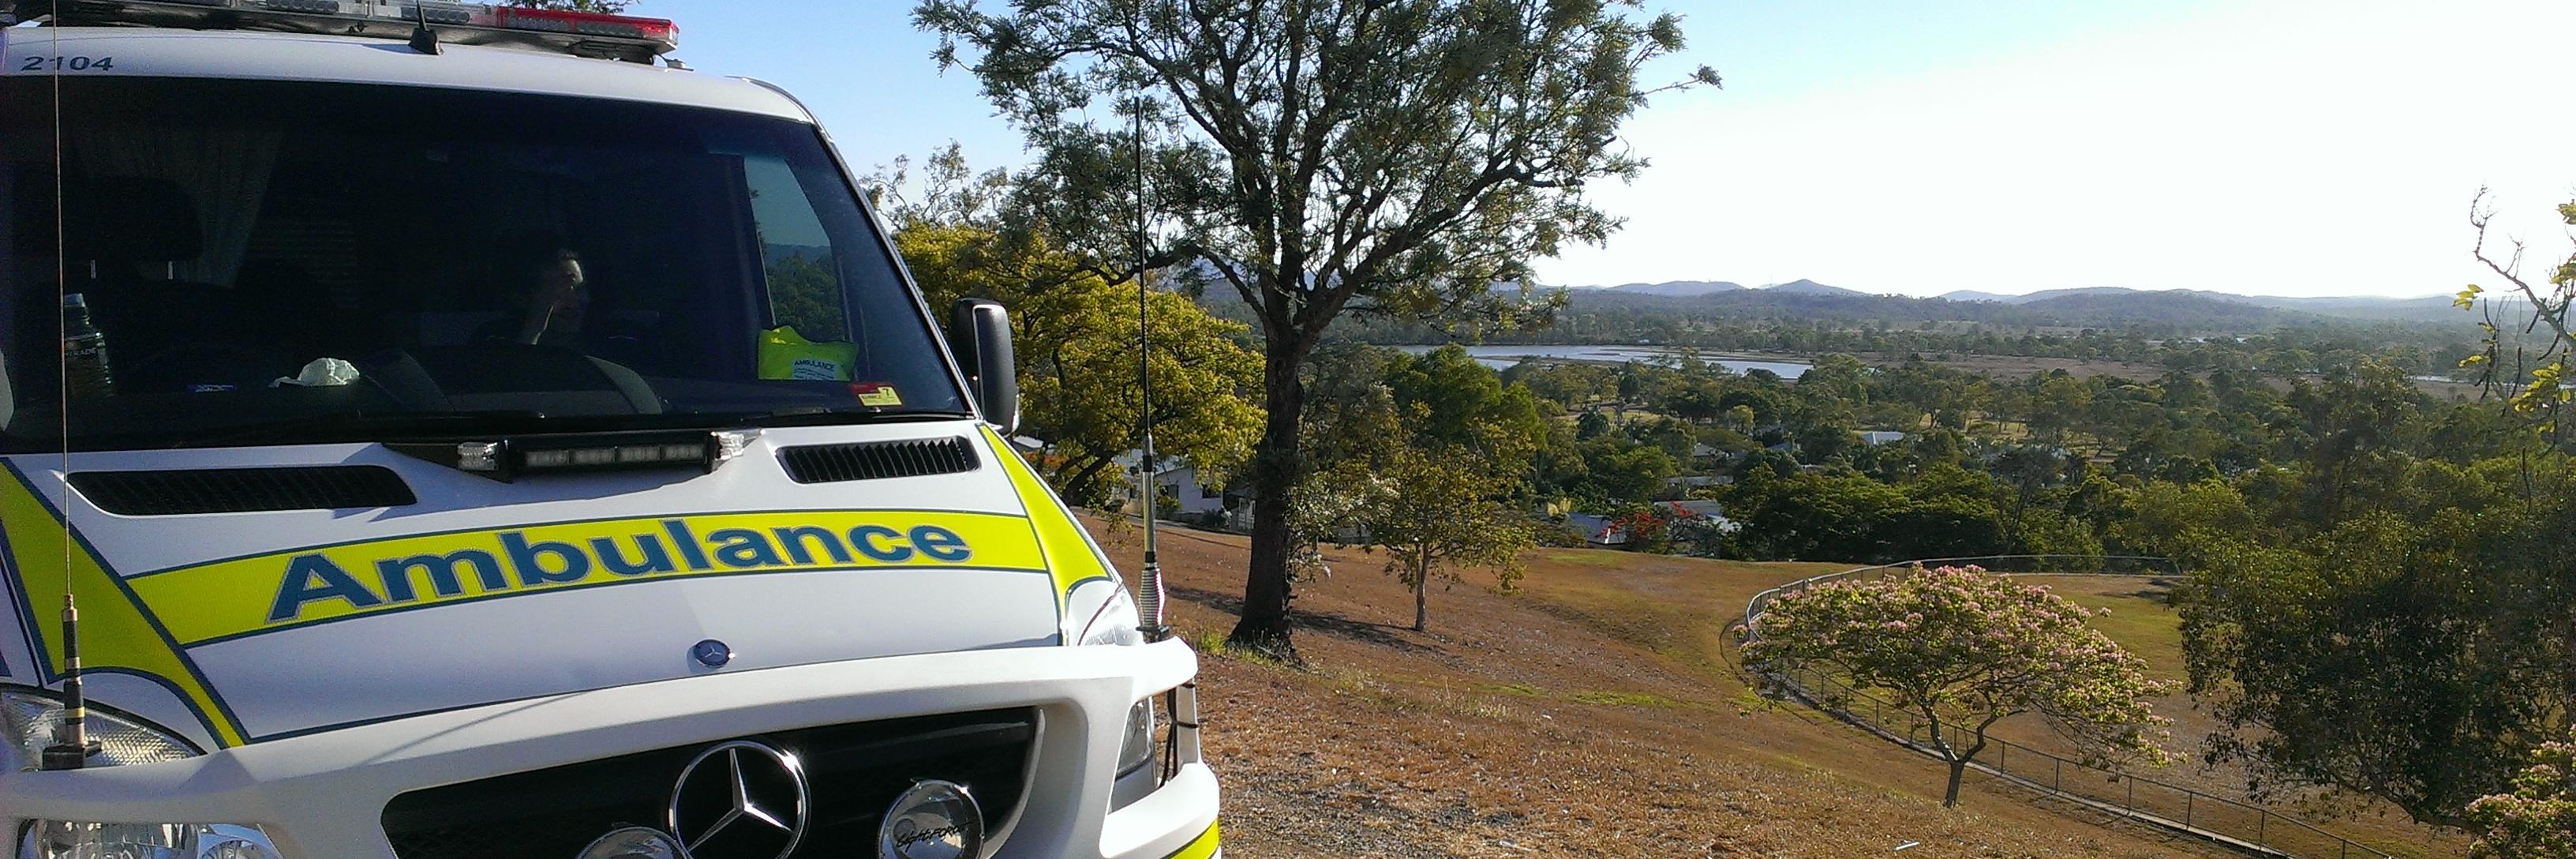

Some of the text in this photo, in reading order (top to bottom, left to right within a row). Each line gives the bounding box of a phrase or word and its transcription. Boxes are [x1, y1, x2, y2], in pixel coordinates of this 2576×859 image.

[21, 56, 114, 71] 2104
[794, 359, 835, 371] AMBULANCE
[264, 518, 972, 622] Ambulance
